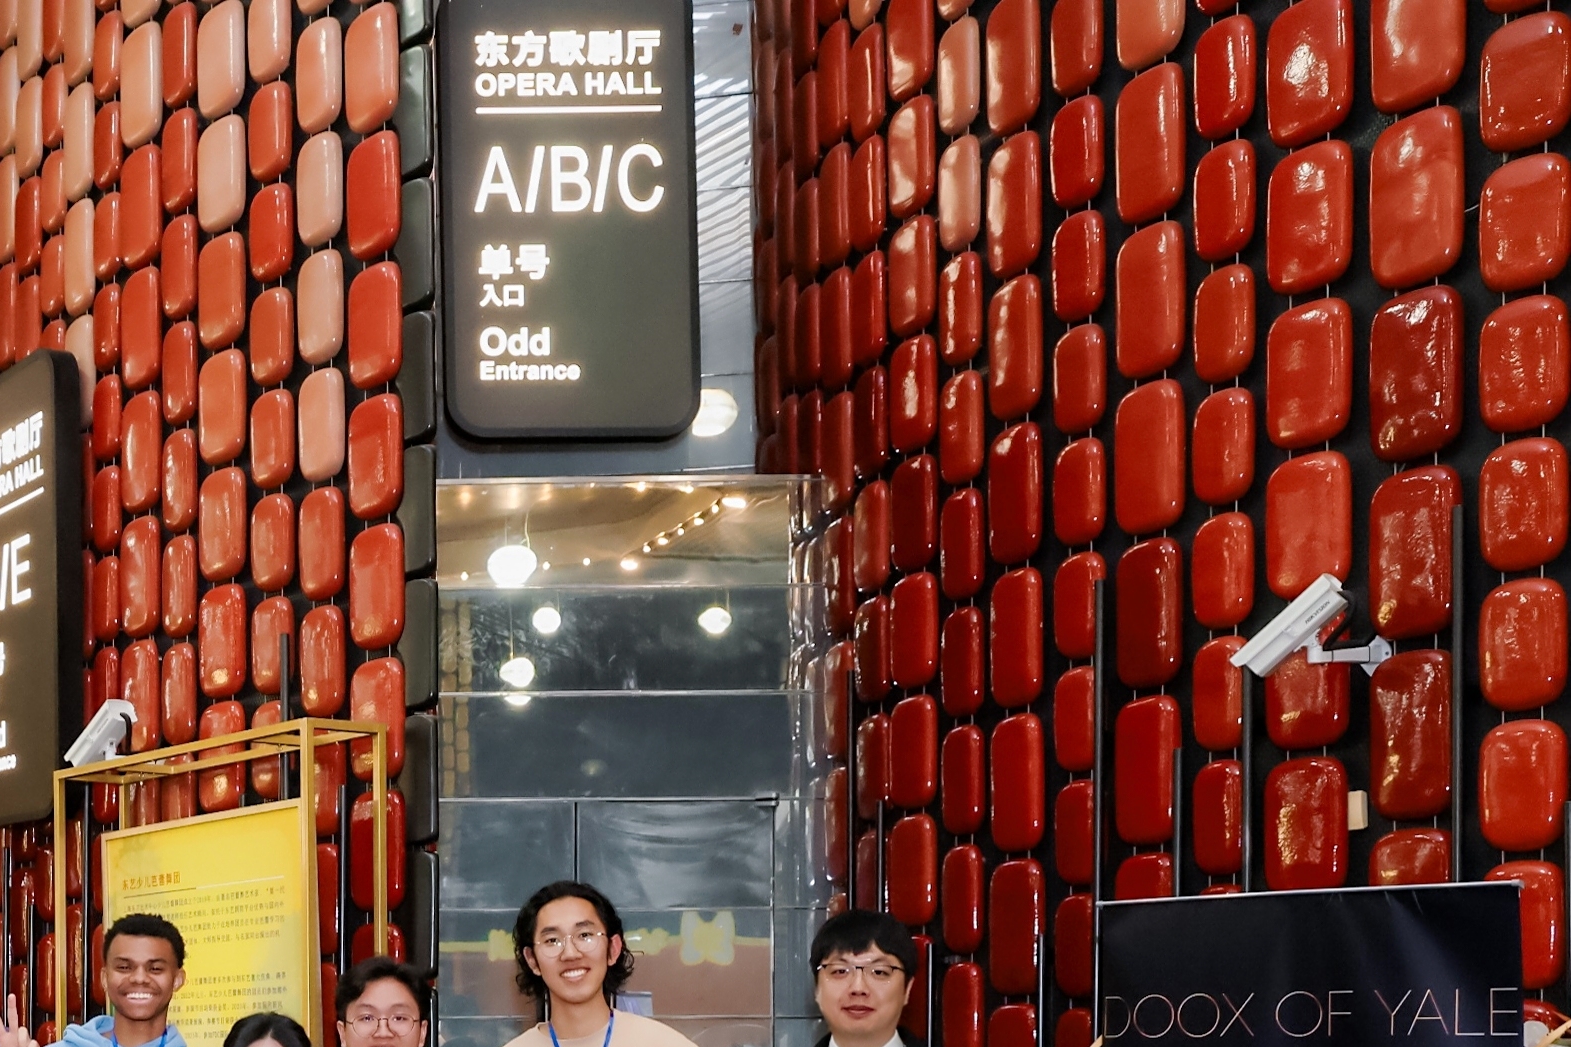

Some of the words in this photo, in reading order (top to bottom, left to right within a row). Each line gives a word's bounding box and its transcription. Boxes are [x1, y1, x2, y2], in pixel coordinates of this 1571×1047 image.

[474, 30, 661, 68] 东方歌剧厅
[475, 72, 578, 97] OPERA
[585, 71, 662, 96] HALL
[474, 143, 665, 213] A/B/C
[478, 243, 550, 281] 单号
[480, 283, 525, 307] 入口
[479, 326, 551, 357] Odd
[479, 360, 581, 381] Entrance
[14, 454, 44, 489] HALL
[1103, 992, 1255, 1038] DOOX
[1275, 990, 1354, 1037] OF
[1374, 987, 1519, 1036] YALE
